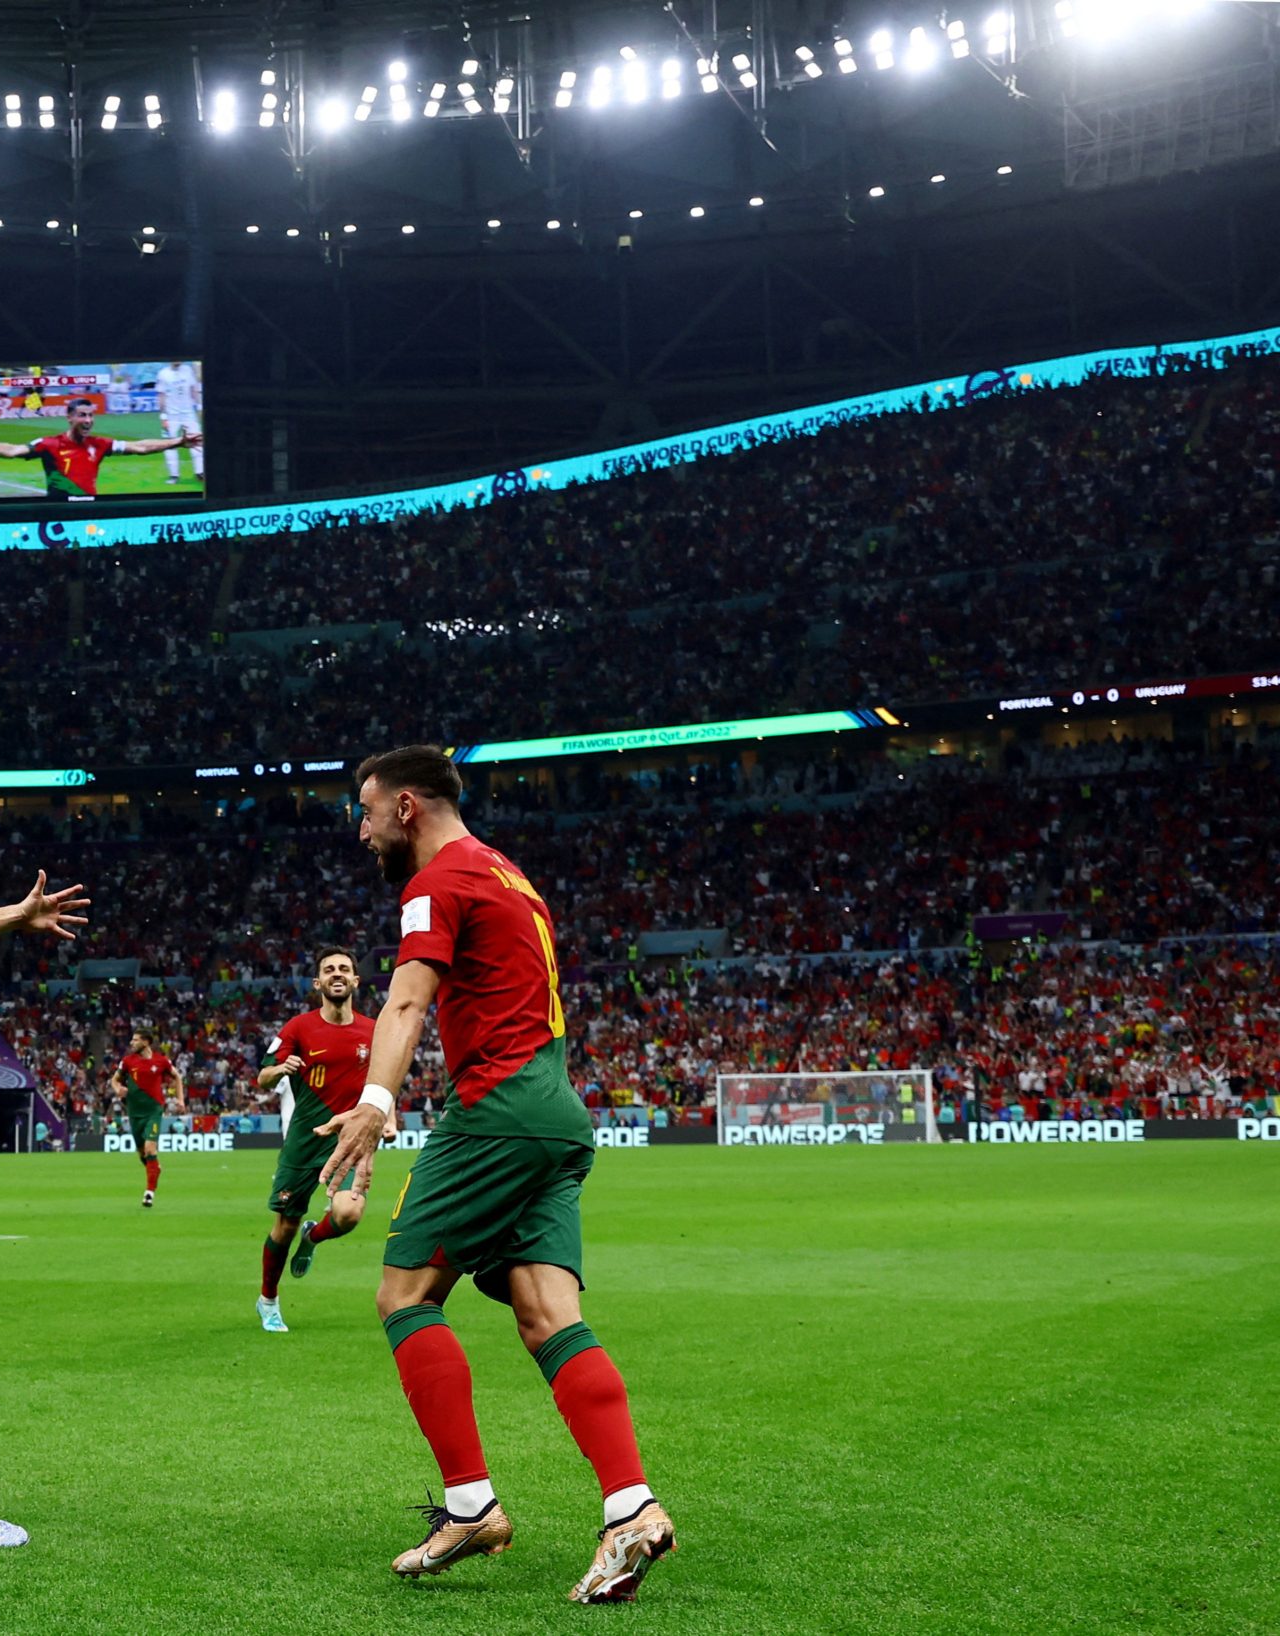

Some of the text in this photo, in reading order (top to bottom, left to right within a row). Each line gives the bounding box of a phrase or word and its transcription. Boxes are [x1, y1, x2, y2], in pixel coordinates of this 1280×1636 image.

[602, 454, 639, 473] FIFA
[640, 440, 704, 464] WORLD
[707, 431, 741, 451] CUP
[150, 522, 185, 537] FIFA
[187, 516, 246, 534] WORLD
[249, 514, 280, 528] CUP
[999, 696, 1053, 711] PORTUGAL
[1072, 691, 1085, 705] 0
[1106, 688, 1119, 702] 0
[1135, 684, 1186, 698] URUGUAY
[562, 739, 586, 750] FIFA
[586, 736, 625, 748] WORLD
[627, 734, 647, 745] CUP
[196, 767, 239, 777] PORTUGAL
[254, 764, 264, 775] 0
[281, 762, 291, 774] 0
[304, 760, 344, 772] URUGUAY
[309, 1064, 326, 1088] 10
[593, 1126, 649, 1147] ADE
[968, 1119, 1145, 1143] POWERADE
[104, 1133, 235, 1153] POERADE
